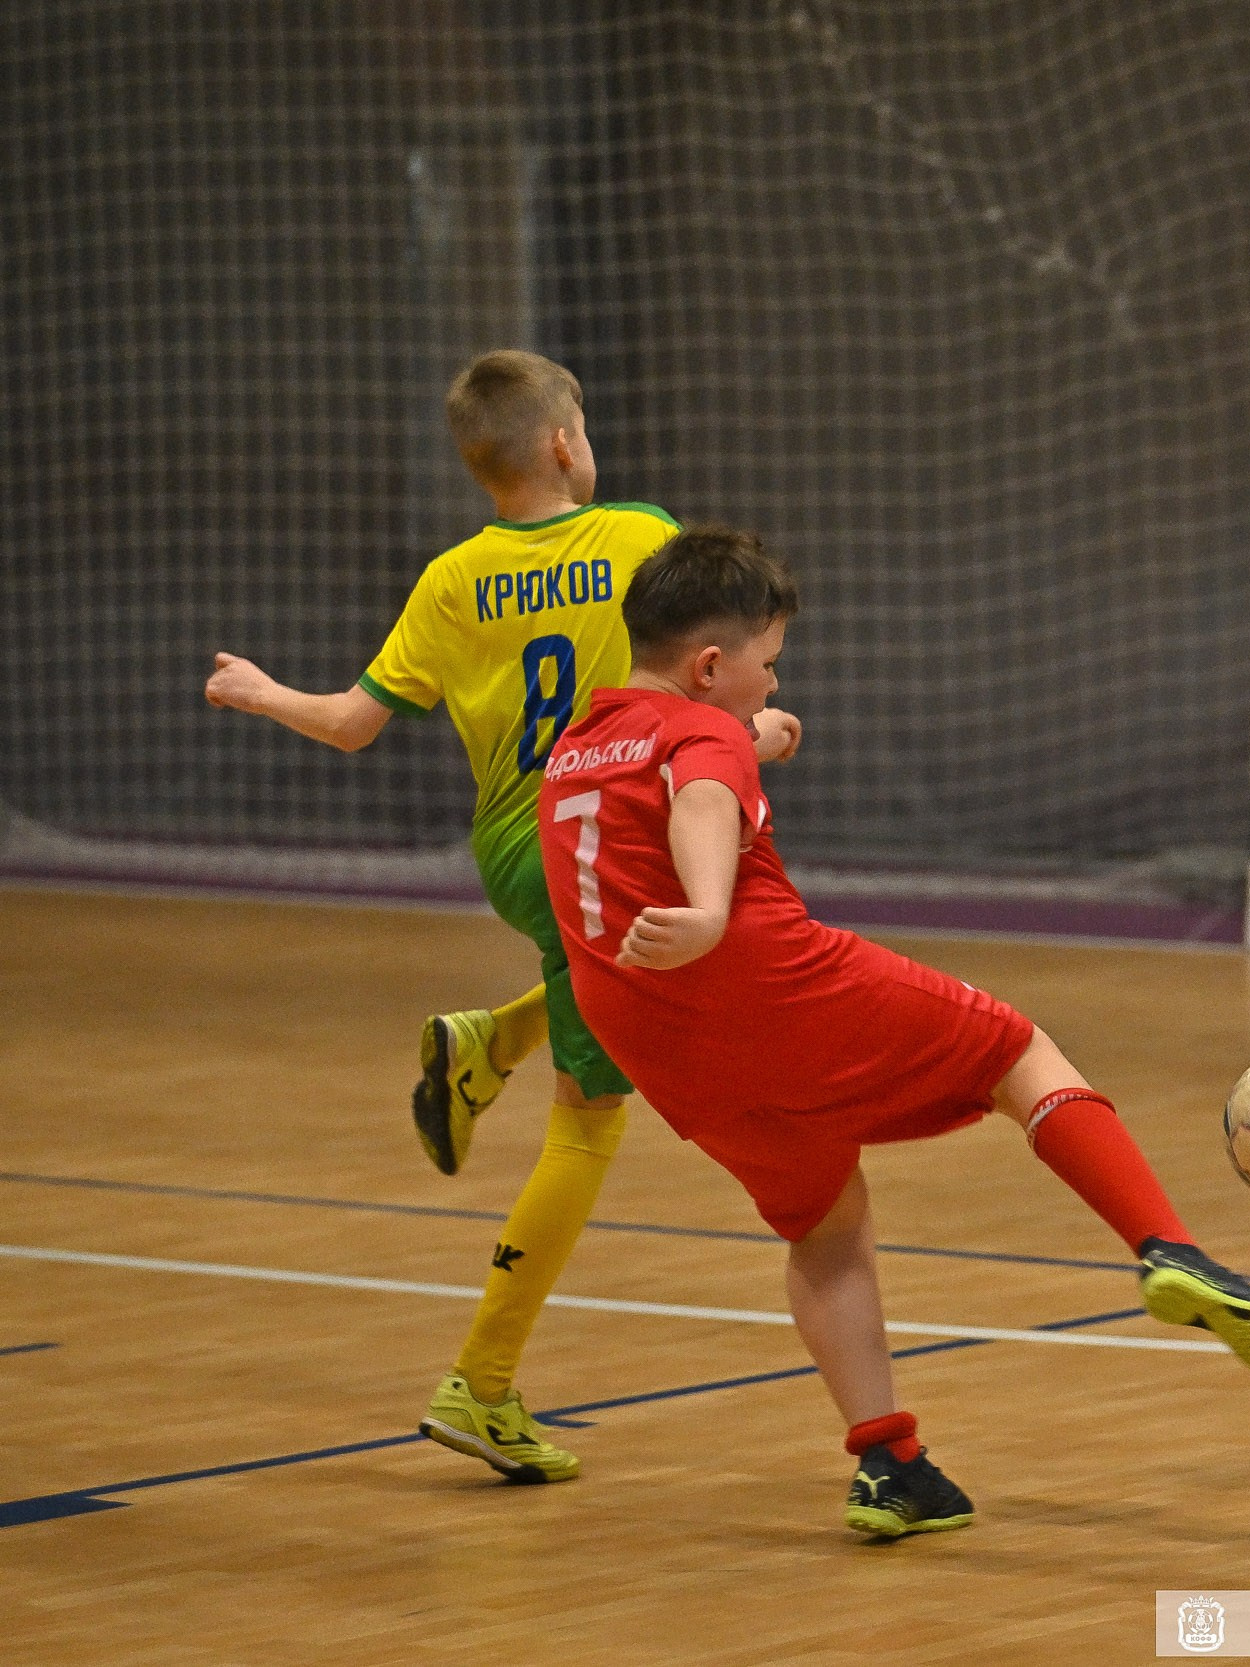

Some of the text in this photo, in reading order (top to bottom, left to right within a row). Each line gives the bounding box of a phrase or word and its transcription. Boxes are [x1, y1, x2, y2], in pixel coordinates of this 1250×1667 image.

[475, 558, 613, 623] КРЮКОВ
[517, 633, 577, 775] 8
[553, 789, 606, 940] 7
